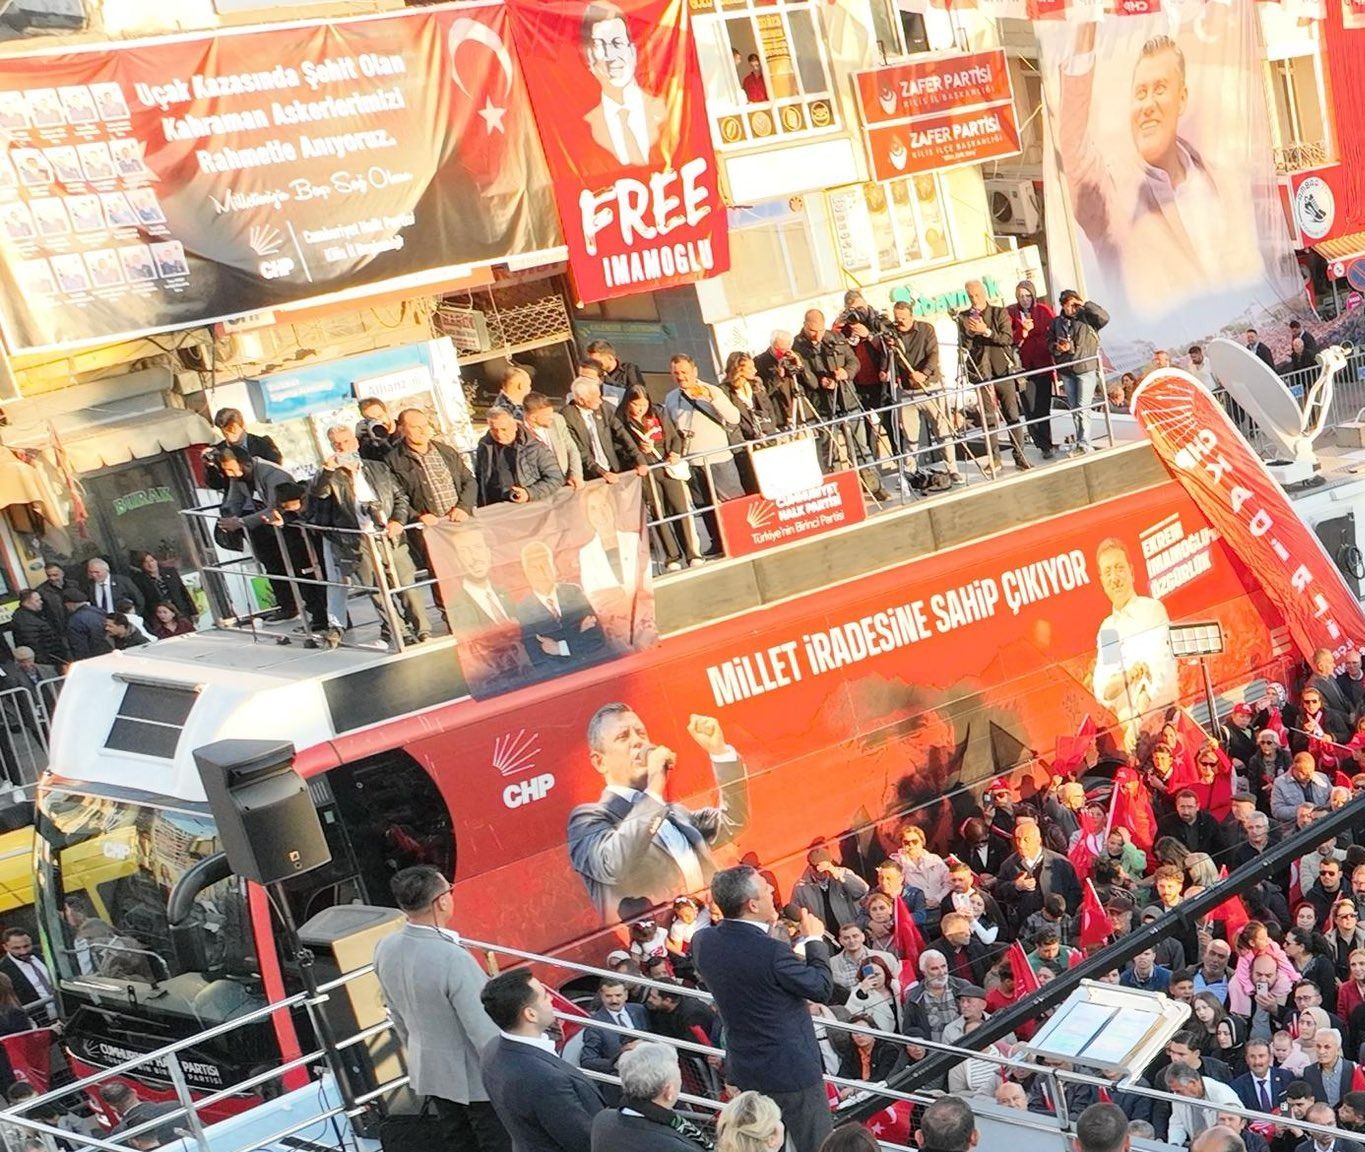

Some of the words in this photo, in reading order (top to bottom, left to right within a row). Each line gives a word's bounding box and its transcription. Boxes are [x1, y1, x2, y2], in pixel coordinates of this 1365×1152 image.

[134, 78, 191, 112] Uçak
[191, 64, 300, 100] Kazasında
[300, 57, 358, 91] Şehit
[359, 54, 406, 78] Olan
[899, 74, 943, 98] ZAFER
[943, 63, 993, 93] PARTİSİ
[161, 108, 269, 142] Kahraman
[271, 87, 406, 126] Askerlerimizi
[908, 126, 953, 150] ZAFER
[952, 112, 1001, 141] PARTİSİ
[195, 138, 298, 175] Rahmetle
[299, 128, 398, 159] Anıyoruz.
[578, 157, 712, 257] FREE
[258, 257, 295, 280] CHP
[602, 237, 715, 288] IMAMOGLU
[705, 640, 803, 708] MİLLET
[802, 601, 933, 676] İRADESİNE
[930, 578, 1000, 634] SAHİP
[1001, 549, 1092, 617] ÇIKIYOR
[502, 771, 556, 810] CHP
